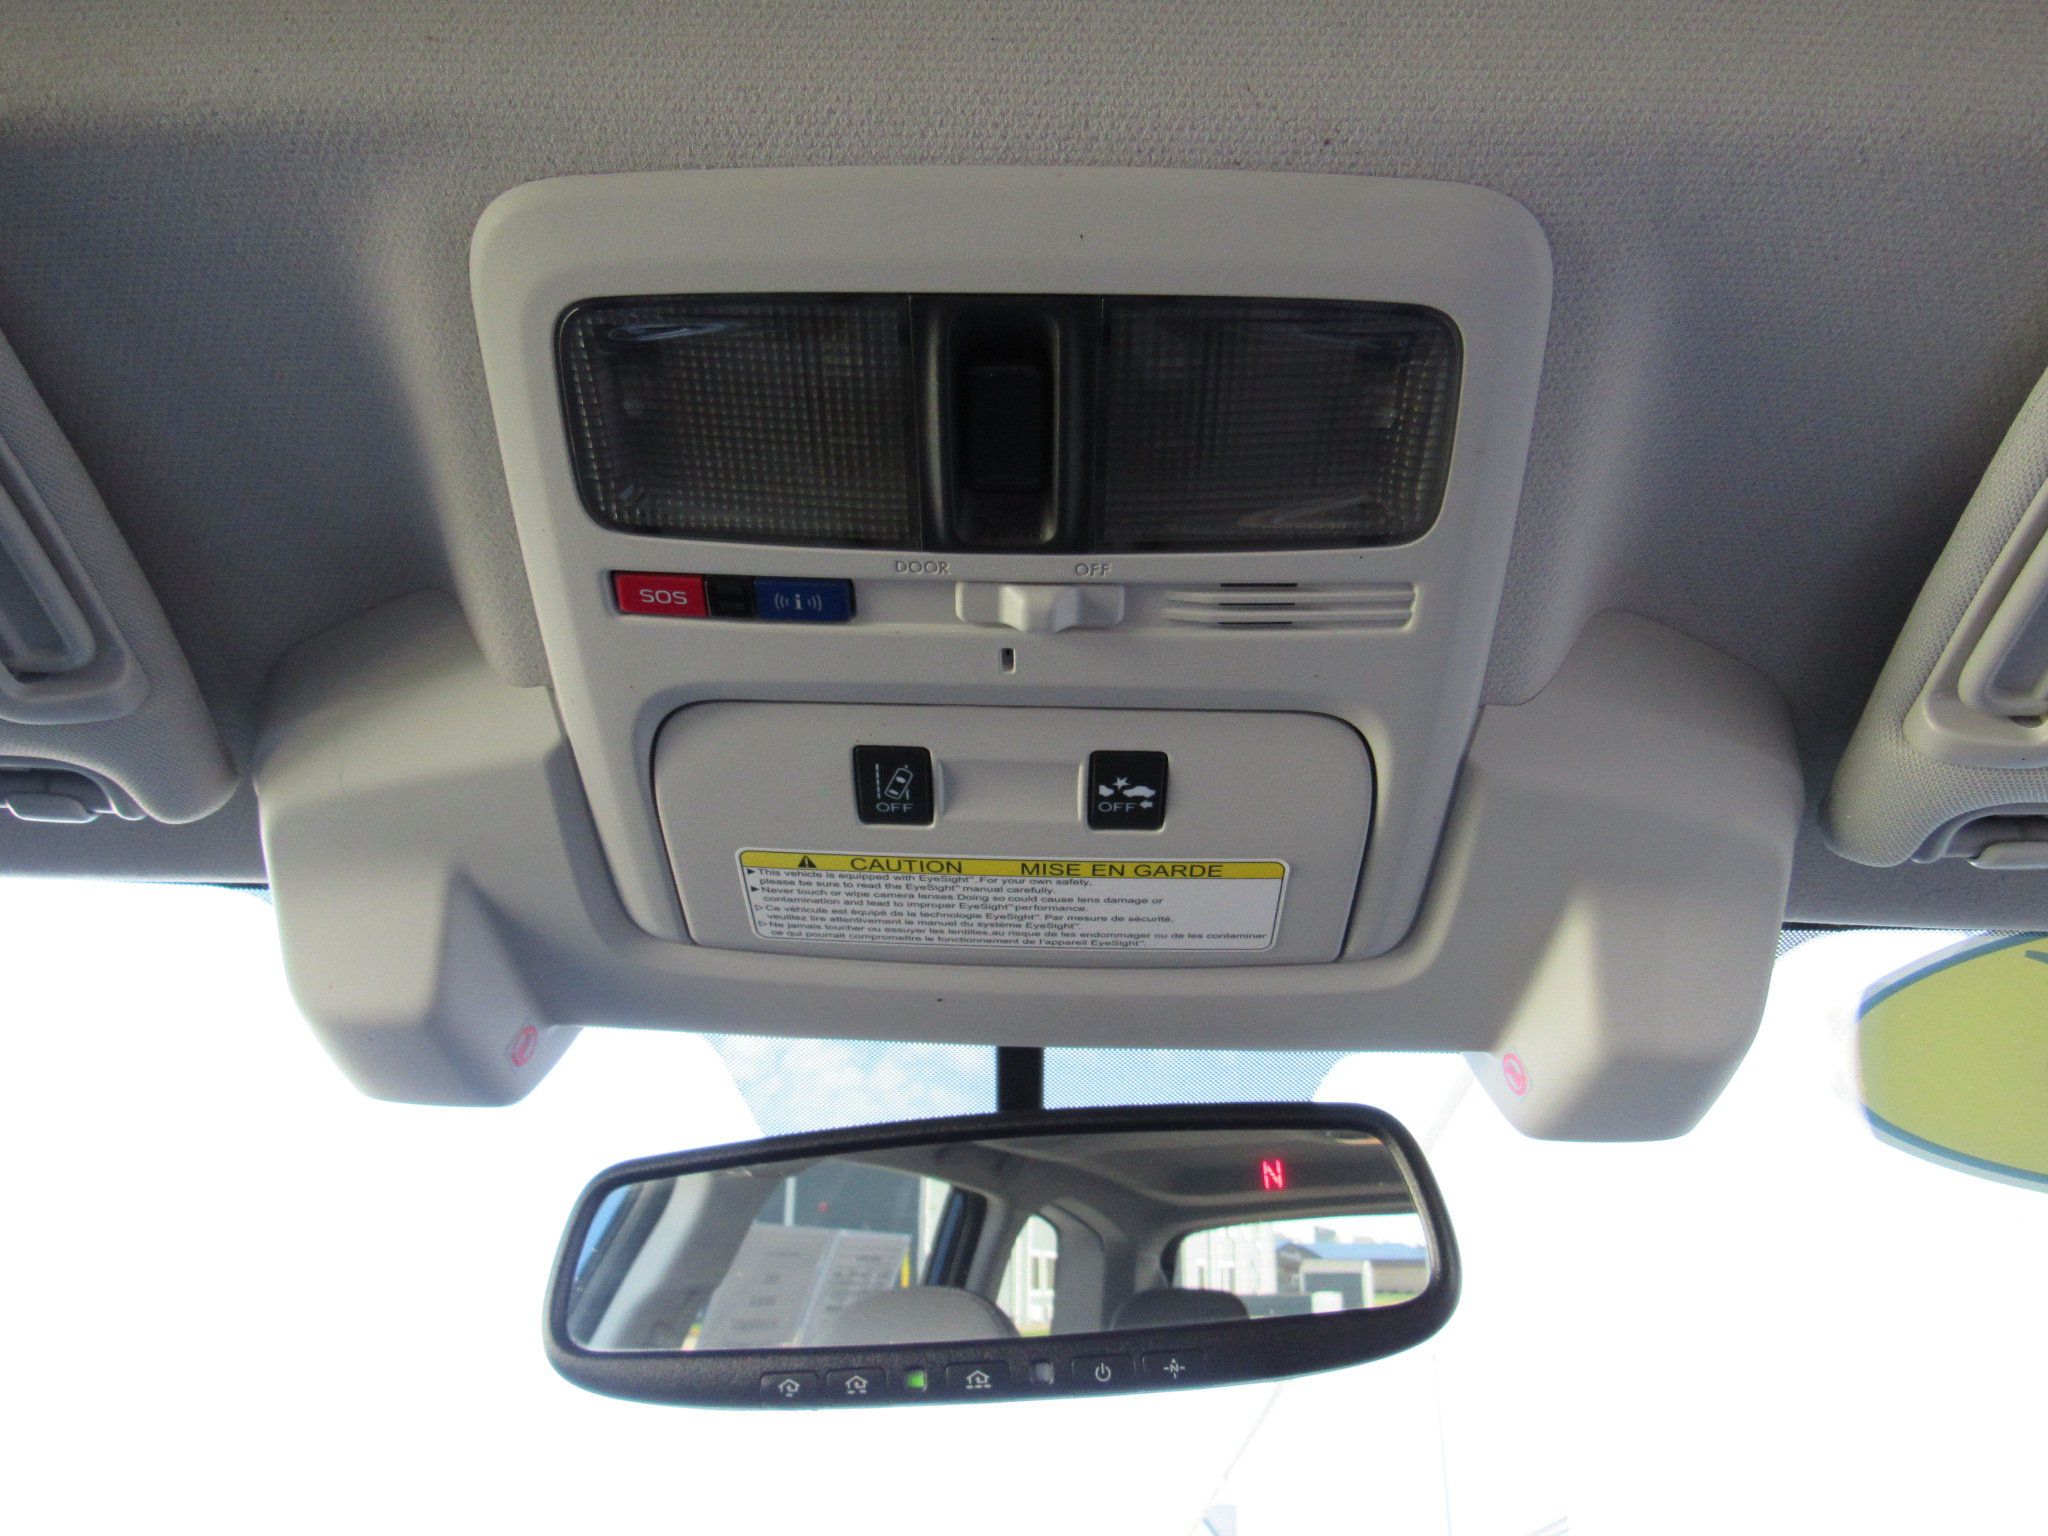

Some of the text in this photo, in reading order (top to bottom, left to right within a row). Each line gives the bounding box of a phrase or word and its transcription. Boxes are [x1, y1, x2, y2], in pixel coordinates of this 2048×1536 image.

[895, 561, 949, 575] DOOR
[1075, 563, 1112, 577] OFF
[639, 589, 688, 604] SOS
[876, 802, 914, 813] OFF
[1098, 801, 1136, 812] OFF
[851, 858, 962, 873] CAUTION
[1021, 863, 1223, 878] MISE EN GARDE
[759, 869, 780, 877] This
[763, 896, 840, 905] contamination
[920, 911, 982, 920] technologie
[788, 922, 821, 931] jamais
[1261, 1159, 1284, 1190] N
